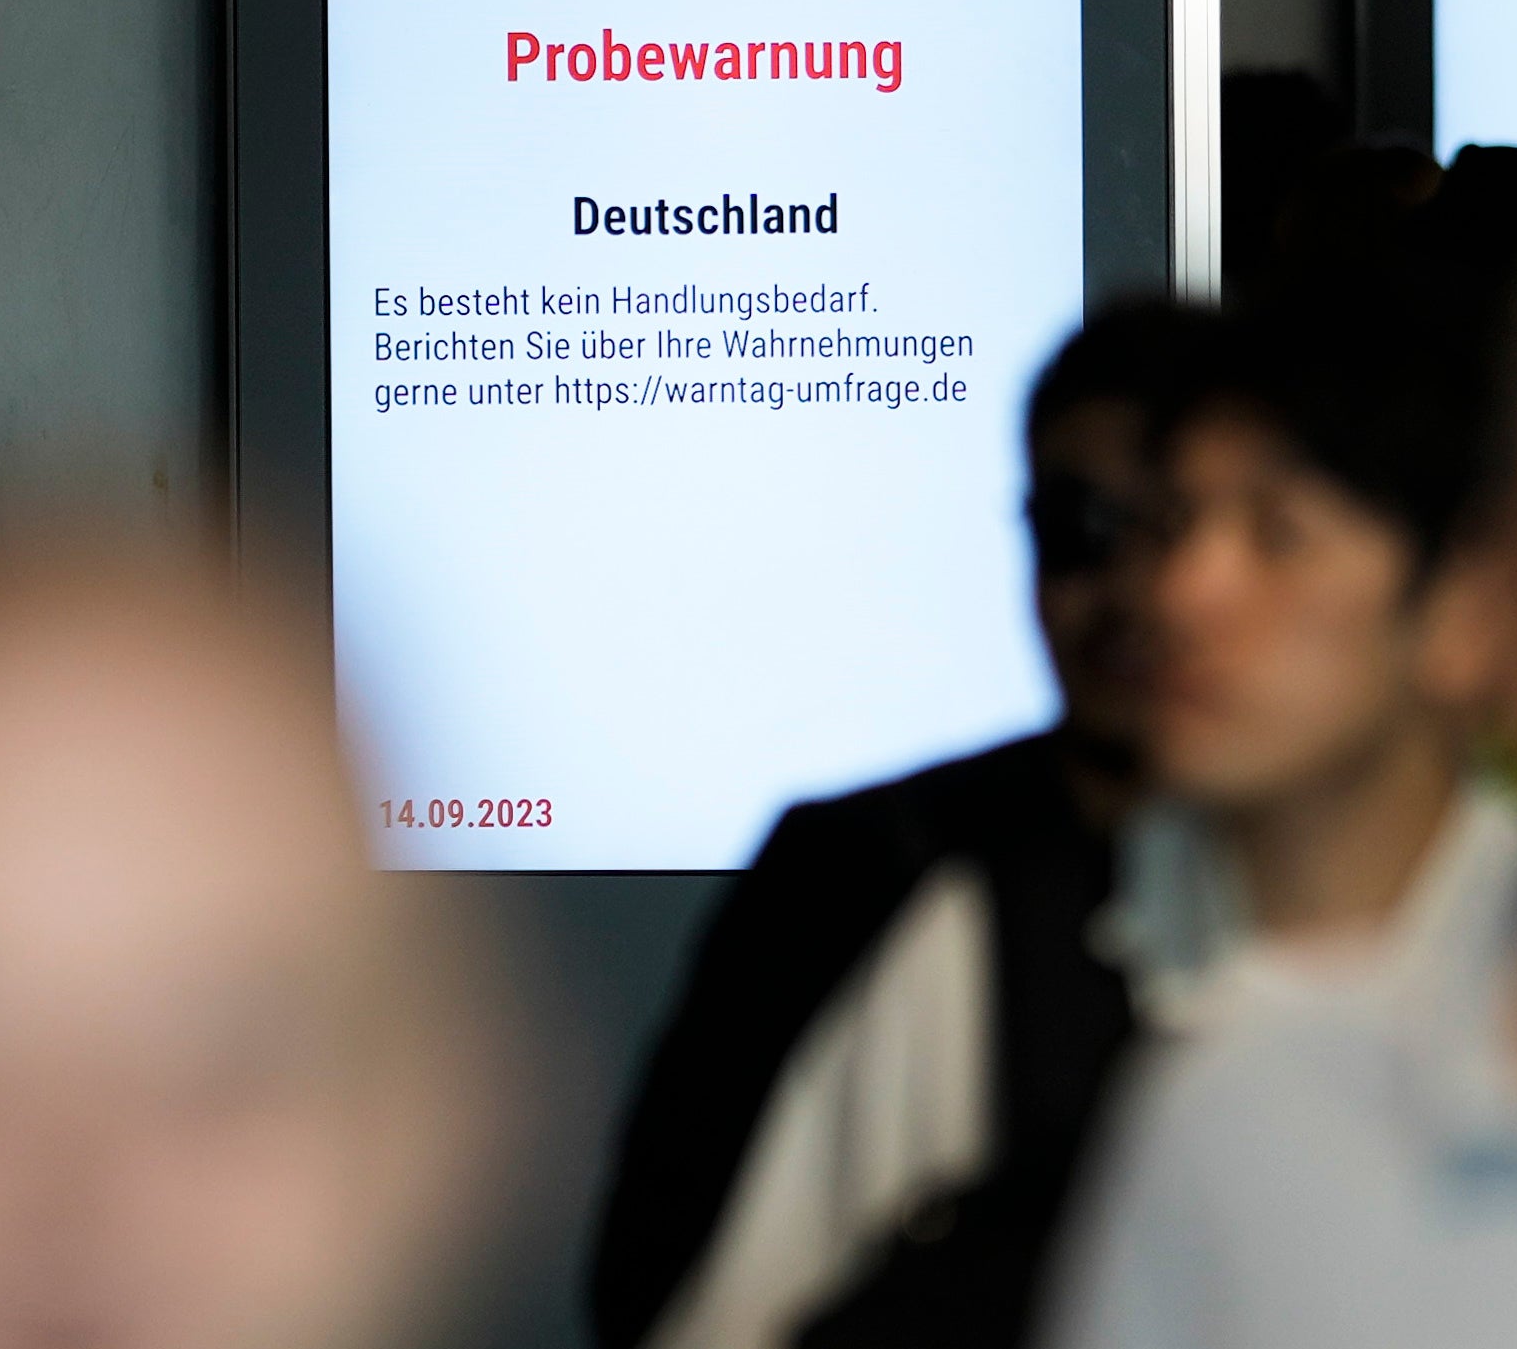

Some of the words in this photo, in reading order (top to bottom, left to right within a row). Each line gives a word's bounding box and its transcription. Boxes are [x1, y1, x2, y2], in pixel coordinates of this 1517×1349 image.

[506, 28, 904, 94] Probewarnung
[572, 192, 839, 236] Deutschland
[375, 287, 408, 317] Es
[419, 285, 530, 317] besteht
[541, 285, 600, 315] kein
[612, 282, 878, 321] Handlungsbedarf.
[375, 330, 514, 362] Berichten
[526, 330, 570, 360] Sie
[581, 329, 646, 360] über
[658, 329, 711, 359] Ihre
[722, 327, 973, 366] Wahrnehmungen
[375, 383, 457, 413] gerne
[469, 378, 544, 406] unter
[555, 373, 967, 410] https://warntag-umfrage.de
[380, 798, 553, 829] 14.09.2023
